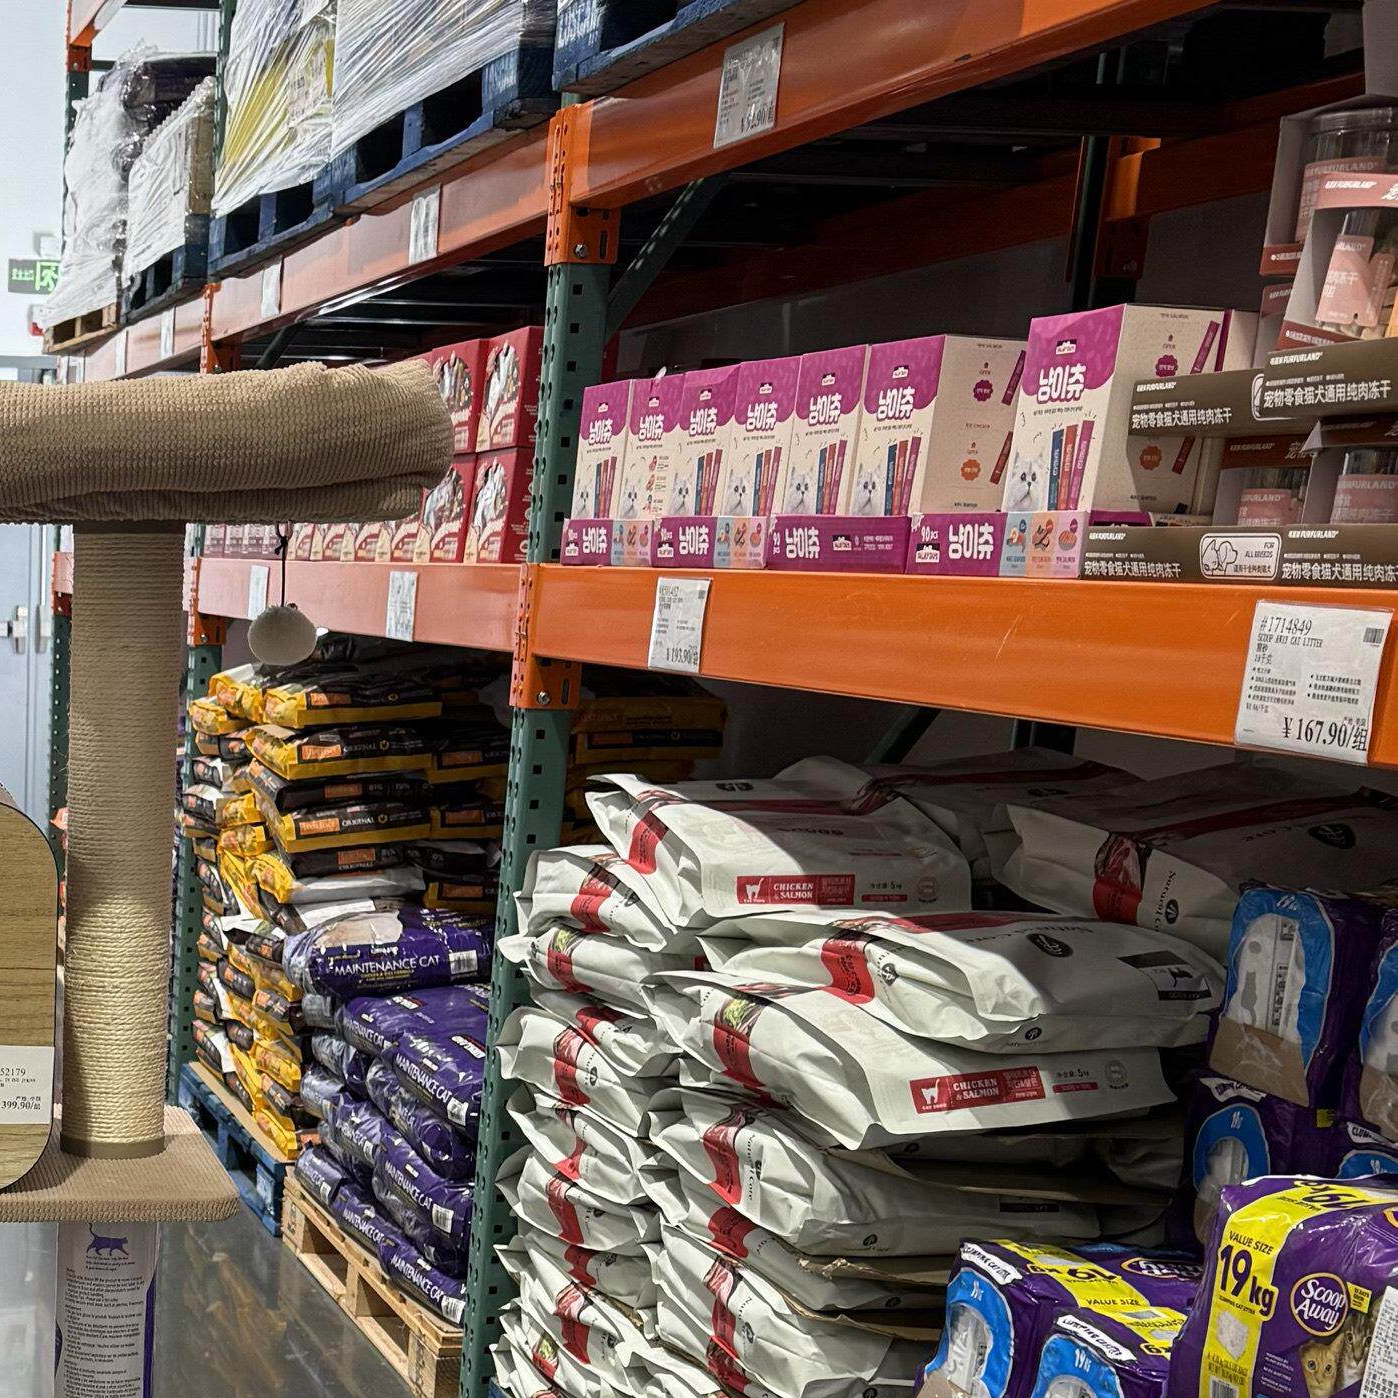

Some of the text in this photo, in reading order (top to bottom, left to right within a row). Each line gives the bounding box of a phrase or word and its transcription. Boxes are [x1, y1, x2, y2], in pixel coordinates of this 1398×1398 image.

[1282, 562, 1398, 582] 宠物零食猫犬通用纯肉冻
[1259, 616, 1313, 636] #1714849
[341, 818, 375, 827] ORIGINAL
[773, 883, 814, 891] CHICKEN
[781, 891, 813, 899] SALMON
[334, 955, 440, 976] MAINTENANCE CAT
[395, 1052, 453, 1103] MAINTENANCE CAT
[953, 1078, 998, 1091] CHICKEN
[962, 1087, 999, 1100] SALMON
[385, 1162, 433, 1210] MAINTENANCE CAT
[342, 1208, 374, 1239] MAINTENANCE
[1229, 1231, 1274, 1255] VALUE SIZE
[390, 1254, 432, 1293] MAINTENANCE
[1086, 1298, 1141, 1306] VALUE SIZE
